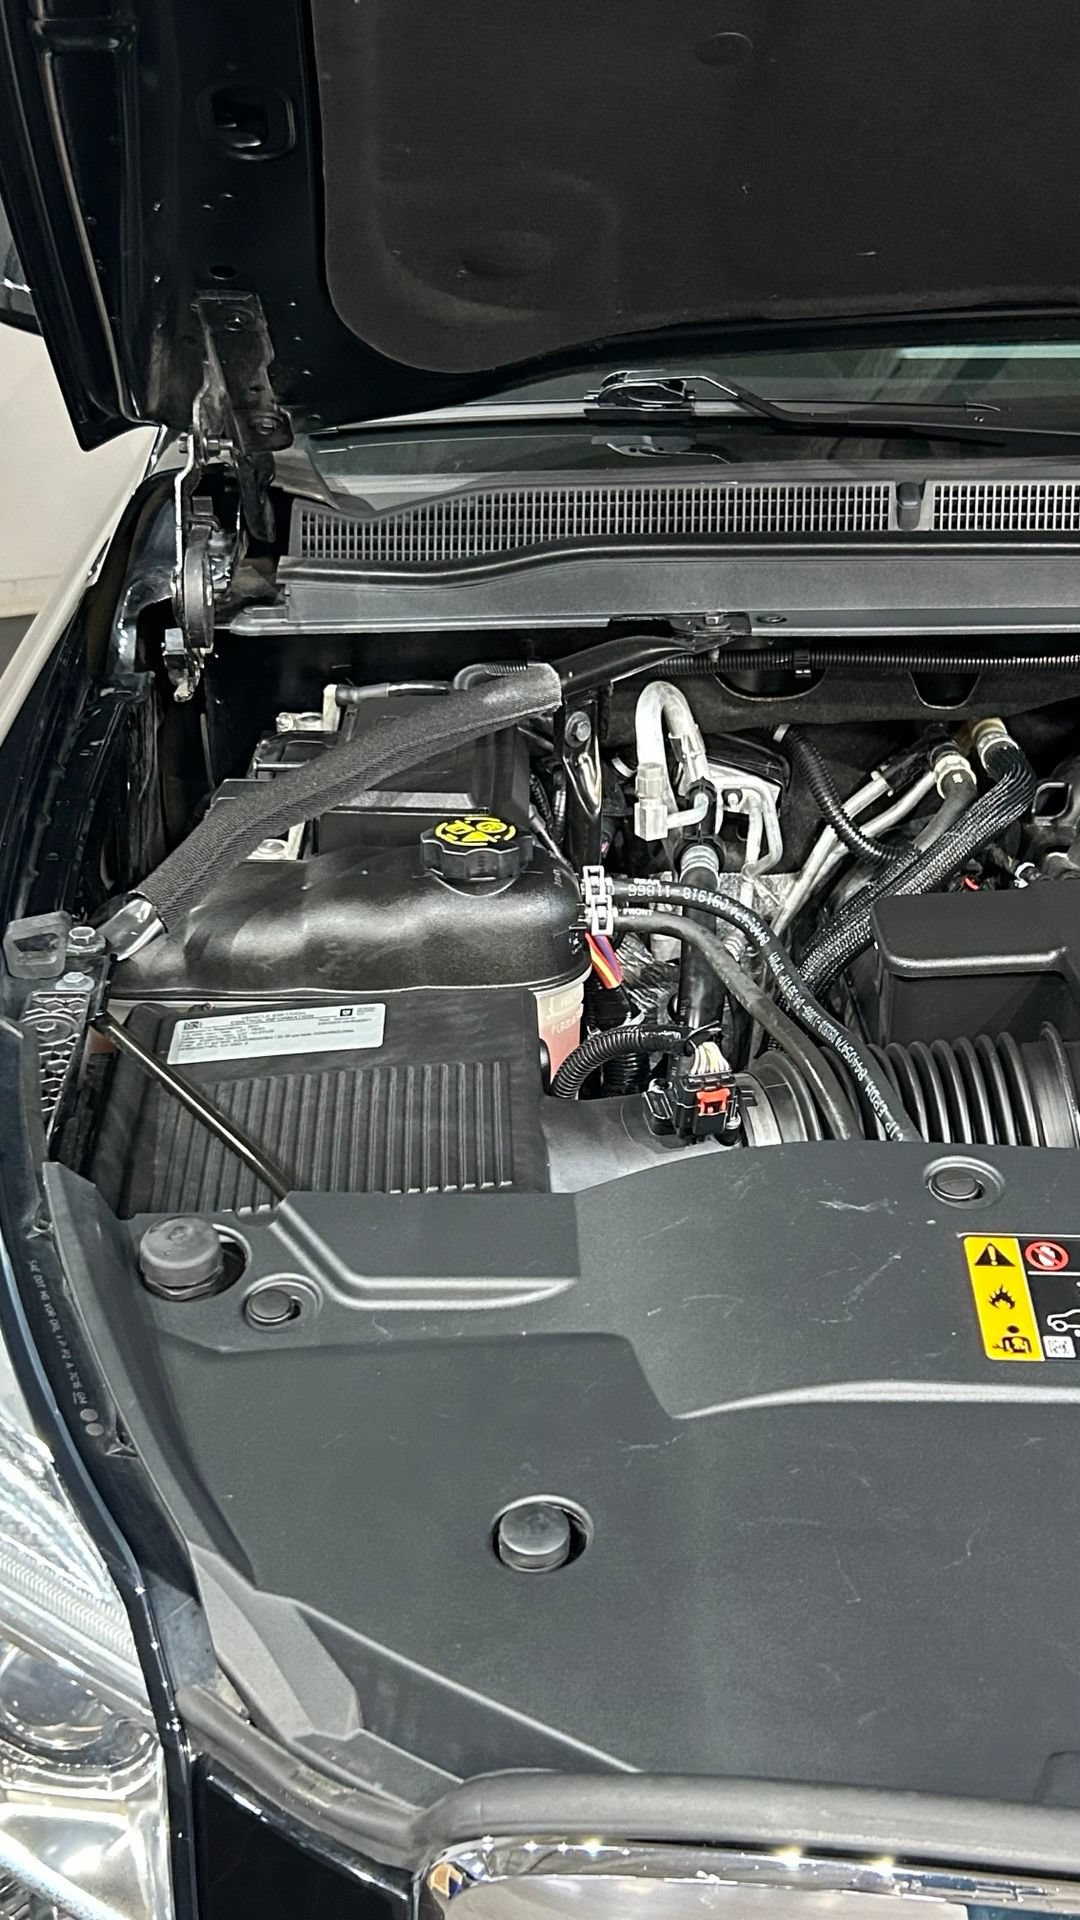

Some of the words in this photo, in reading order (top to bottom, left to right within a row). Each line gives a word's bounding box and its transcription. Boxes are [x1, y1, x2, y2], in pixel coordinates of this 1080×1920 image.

[622, 907, 654, 916] FRONT
[835, 1033, 868, 1082] 84405474
[865, 1080, 889, 1118] EPDM
[33, 1274, 46, 1288] DOT
